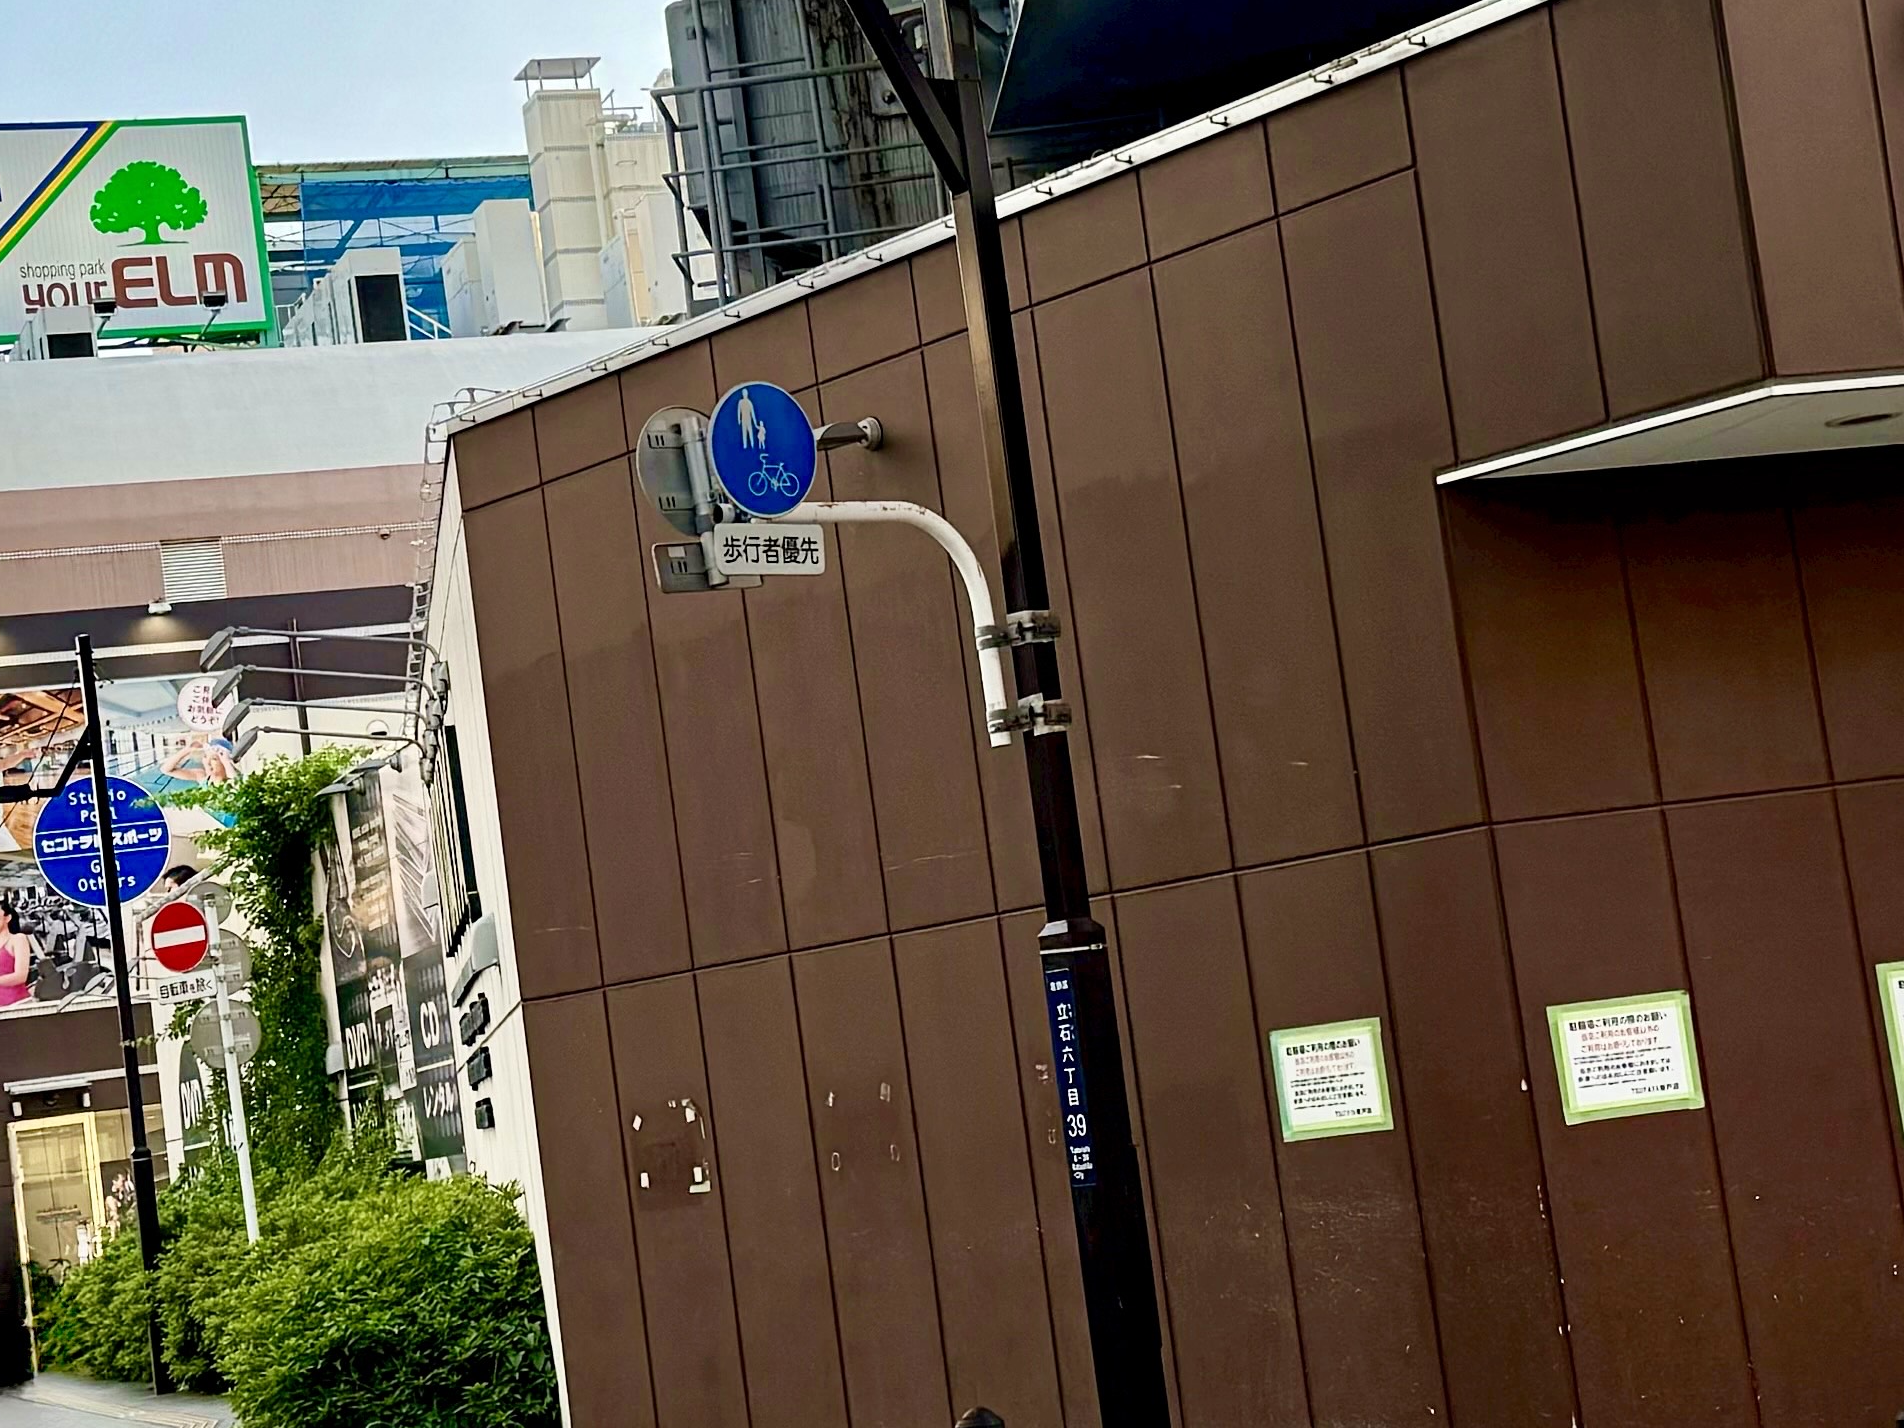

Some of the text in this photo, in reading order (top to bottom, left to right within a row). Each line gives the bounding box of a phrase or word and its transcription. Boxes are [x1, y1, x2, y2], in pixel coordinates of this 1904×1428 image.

[19, 259, 106, 280] shopping park
[111, 253, 248, 309] ELM
[723, 535, 820, 565] 歩行者優先
[68, 790, 127, 806] Stuio
[80, 806, 118, 823] Pol
[77, 875, 136, 892] Othrs
[159, 977, 213, 999] 自転車を除く
[419, 1001, 440, 1049] CD
[345, 1022, 371, 1070] DVD
[1056, 1002, 1080, 1107] 立石六丁目
[1066, 1113, 1087, 1138] 39
